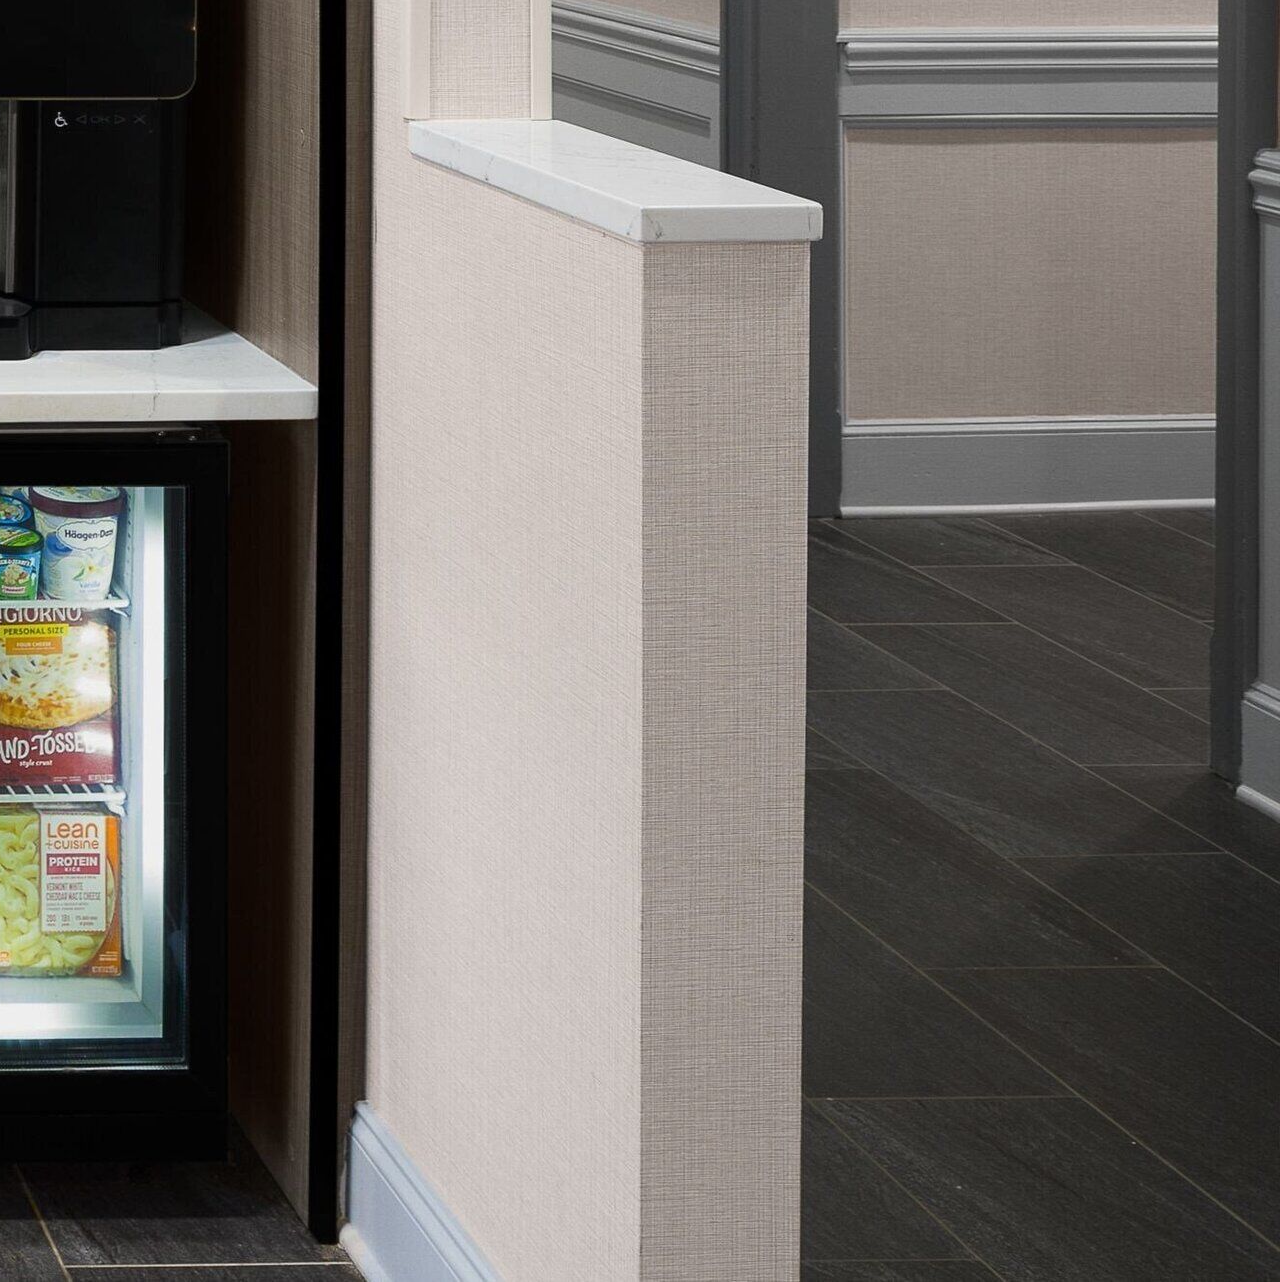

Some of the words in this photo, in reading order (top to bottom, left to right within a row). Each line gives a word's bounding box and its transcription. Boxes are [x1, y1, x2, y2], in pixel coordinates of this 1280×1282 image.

[3, 627, 46, 635] PERSONAL
[47, 627, 64, 635] SIZE
[19, 759, 35, 769] style
[36, 759, 53, 767] crust
[47, 822, 99, 839] Lean
[48, 856, 98, 867] PROTEIN
